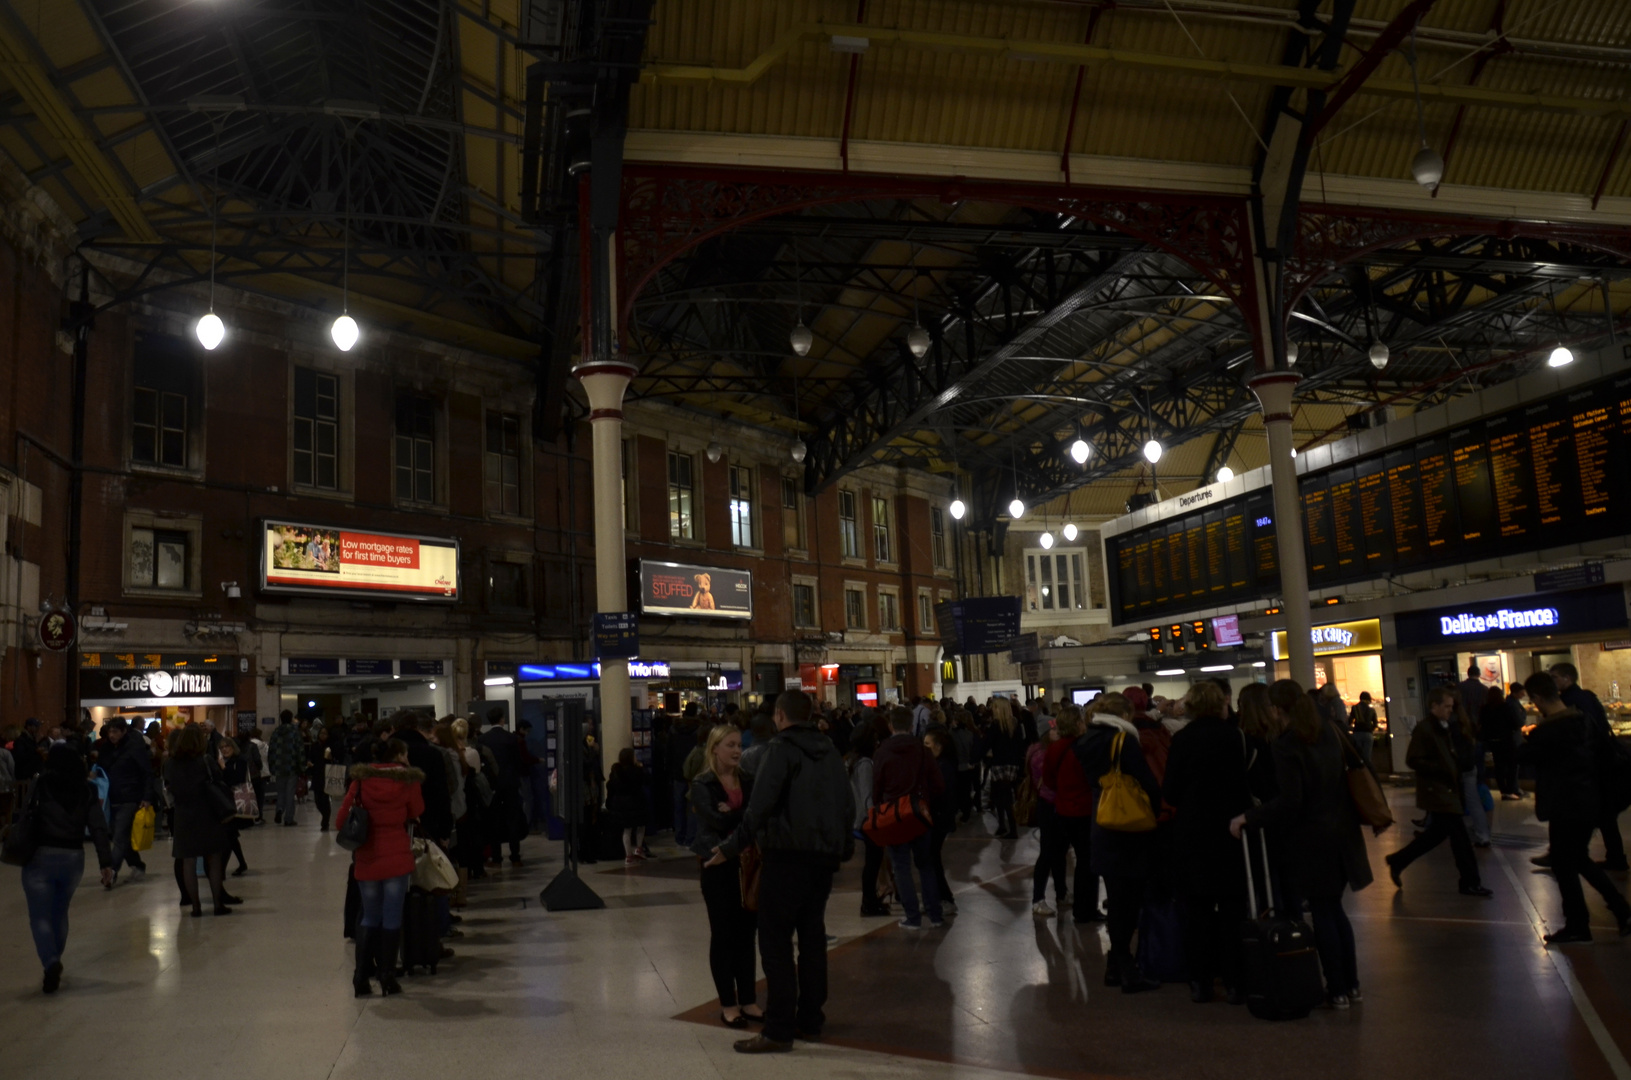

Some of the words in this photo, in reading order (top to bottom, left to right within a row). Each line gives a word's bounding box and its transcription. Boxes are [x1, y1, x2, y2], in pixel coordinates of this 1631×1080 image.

[1179, 490, 1213, 507] Departures
[342, 538, 358, 549] Low
[359, 541, 395, 555] mortgage
[396, 543, 413, 554] rates
[342, 549, 353, 559] for
[354, 550, 368, 560] first
[369, 552, 385, 562] time
[386, 553, 411, 565] buyers
[652, 582, 693, 598] STUFFED
[1440, 613, 1486, 635] Delice
[1486, 614, 1498, 628] de
[1497, 608, 1555, 630] France
[1323, 628, 1353, 647] CRUST
[110, 674, 149, 692] Caffè
[173, 675, 211, 693] RITAZZA
